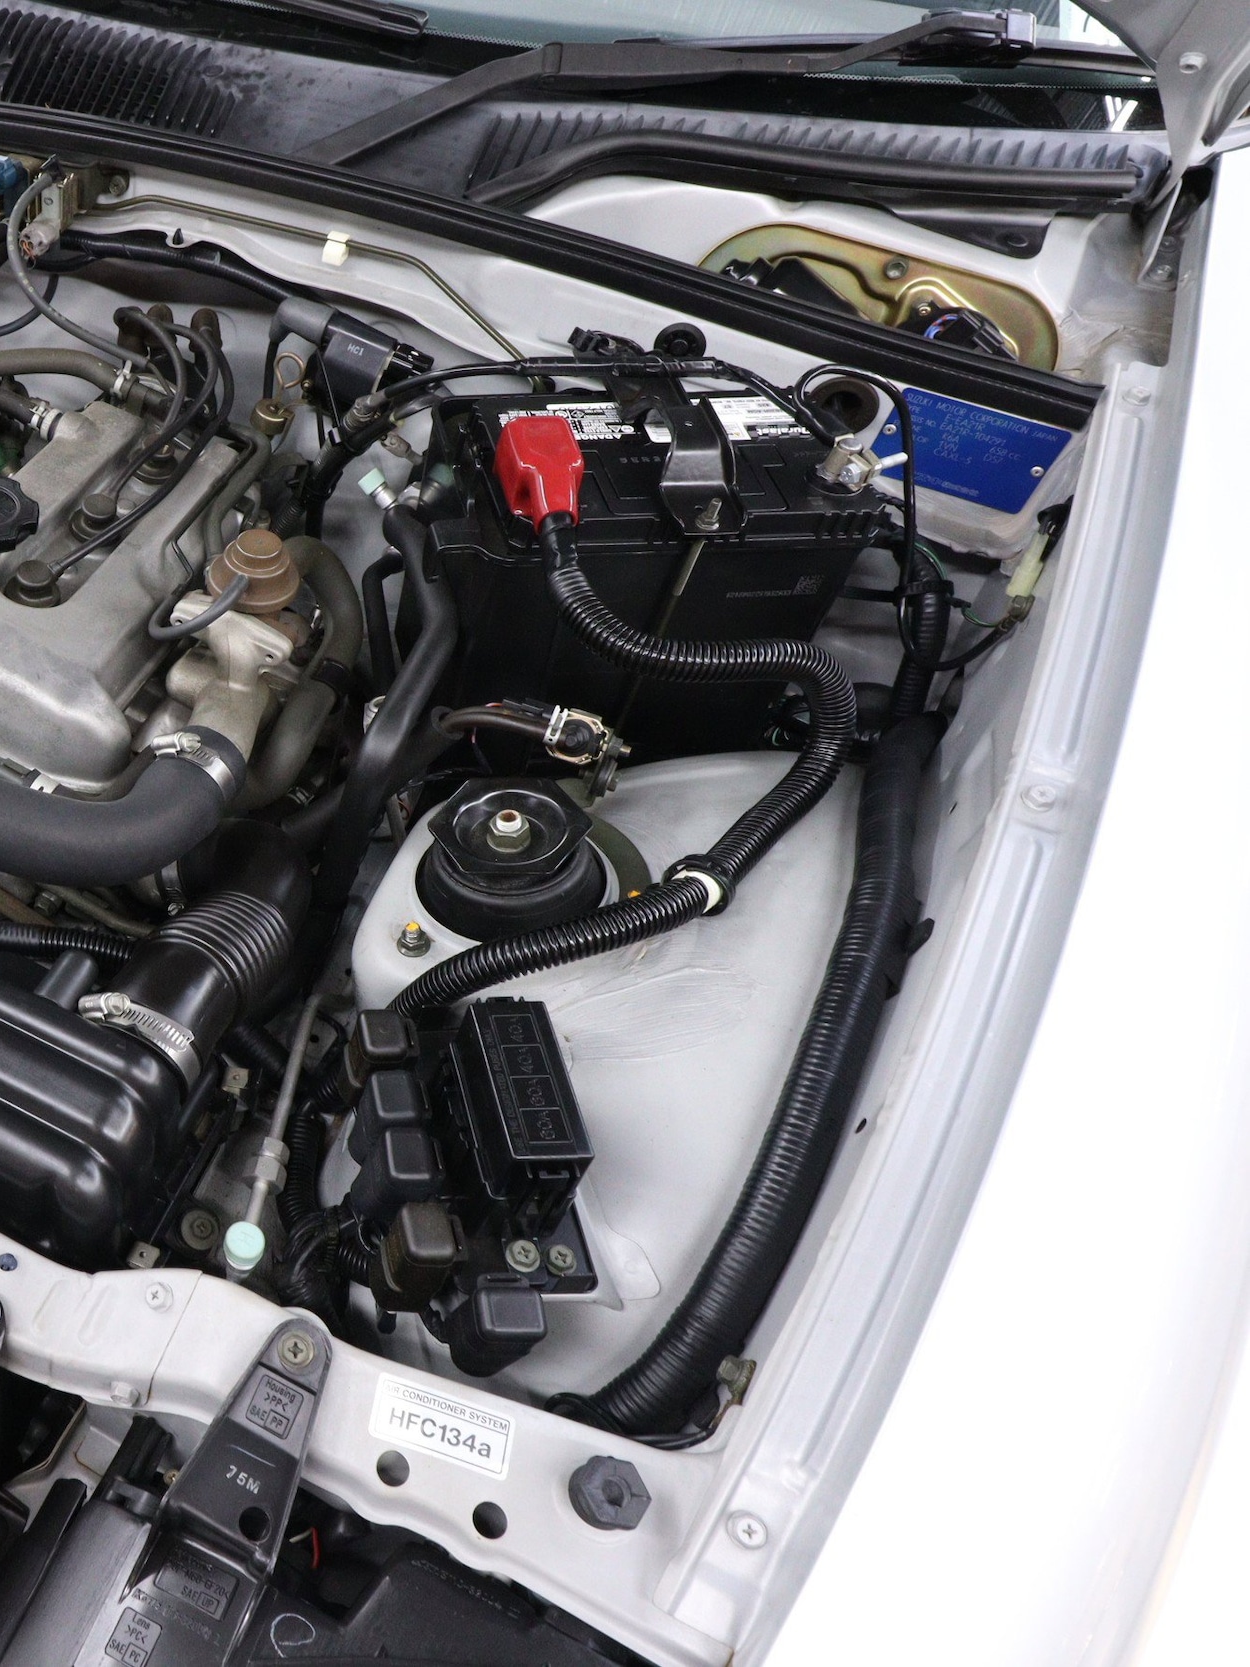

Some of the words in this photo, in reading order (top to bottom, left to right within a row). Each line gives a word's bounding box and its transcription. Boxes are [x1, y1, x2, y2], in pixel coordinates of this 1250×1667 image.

[907, 393, 933, 406] SUZUKI
[935, 402, 967, 417] MOTOR
[970, 411, 1030, 434] CORPORATION
[1031, 431, 1058, 442] JAPAN
[944, 413, 986, 432] E-EA21R
[265, 1378, 296, 1404] Housing
[249, 1405, 267, 1422] SAE
[269, 1416, 284, 1429] PP
[386, 1384, 400, 1395] AIR
[402, 1389, 467, 1417] CONDITIONER
[468, 1411, 508, 1432] SYSTEM
[389, 1407, 492, 1459] HFC134a
[181, 1585, 199, 1600] SAE
[132, 1612, 151, 1630] Lens
[109, 1639, 127, 1655] SAE
[129, 1649, 141, 1664] PC
